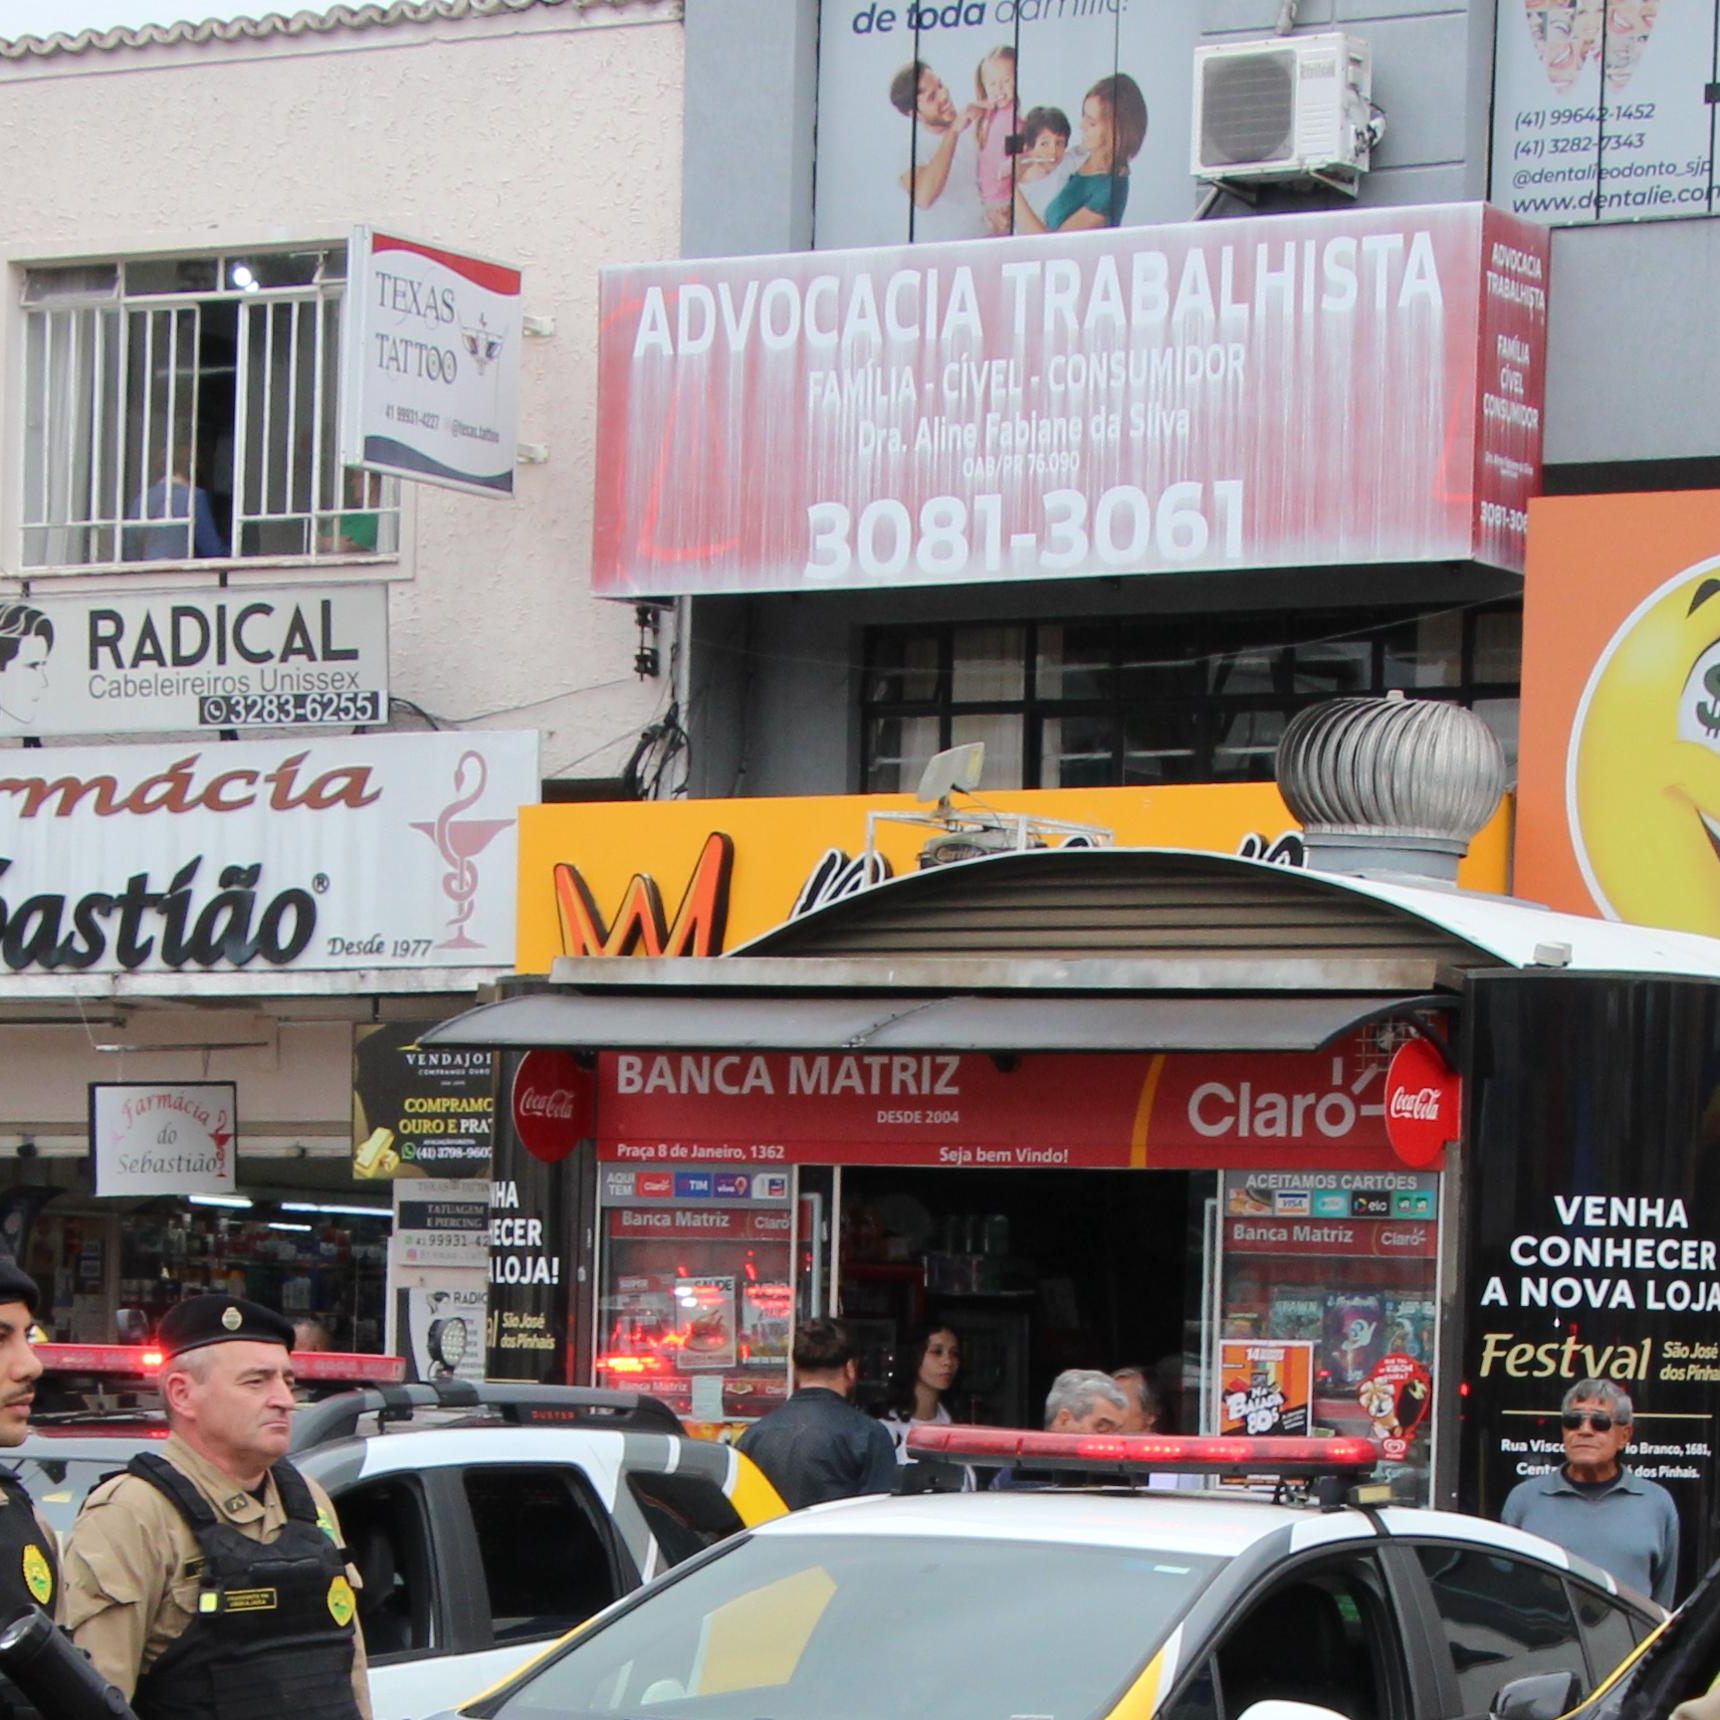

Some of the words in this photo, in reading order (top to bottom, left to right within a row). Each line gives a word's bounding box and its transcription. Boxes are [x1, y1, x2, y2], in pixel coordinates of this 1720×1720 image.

[852, 8, 897, 34] de
[907, 0, 985, 31] toda
[1514, 110, 1546, 131] (41)
[1550, 103, 1656, 126] 99642-1452
[1514, 141, 1545, 159] (41)
[1513, 156, 1713, 189] @dentalieodonto_sjp
[1491, 243, 1542, 277] ADVOCACIA
[375, 271, 456, 325] TEXAS
[633, 266, 983, 357] ADVOCACIA
[1001, 231, 1444, 335] TRABALHISTA
[1486, 271, 1546, 309] TRABALHISTA
[375, 332, 458, 384] TATTOO
[1497, 335, 1530, 364] FAMÍLIA
[807, 357, 918, 408] FAMÍLIA
[942, 353, 1022, 400] CÍVEL
[1048, 343, 1246, 392] CONSUMIDOR
[1483, 393, 1539, 428] CONSUMIDOR
[859, 421, 907, 455] Dra.
[915, 416, 976, 452] Aline
[984, 409, 1081, 446] Fabiane
[1091, 406, 1120, 439] da
[1129, 402, 1190, 437] Silva
[804, 479, 1245, 582] 3081-3061
[88, 599, 360, 670] RADICAL
[88, 669, 250, 699] Cabeleireiros
[260, 667, 360, 692] Unissex
[230, 693, 373, 723] 3283-6255
[327, 936, 385, 959] Desde
[391, 938, 432, 959] 1977
[616, 1055, 775, 1095] BANCA
[788, 1055, 961, 1095] MATRIZ
[877, 1109, 923, 1124] DESDE
[926, 1110, 959, 1124] 2004
[1187, 1081, 1357, 1138] Claro
[156, 1122, 177, 1145] do
[398, 1118, 445, 1133] OURO
[447, 1119, 458, 1133] E
[116, 1150, 218, 1174] Sebastião
[617, 1143, 655, 1160] Praça
[657, 1144, 667, 1158] 8
[669, 1143, 688, 1158] de
[690, 1144, 747, 1160] Janeiro,
[750, 1145, 784, 1159] 1362
[939, 1147, 972, 1164] Seja
[975, 1146, 1012, 1162] bem
[1015, 1147, 1069, 1163] Vindo!
[606, 1172, 635, 1185] AQUI
[608, 1184, 632, 1196] TEM
[689, 1179, 709, 1191] TIM
[1245, 1174, 1337, 1189] ACEITAMOS
[1340, 1173, 1418, 1190] CARTÕES
[427, 1204, 484, 1214] TATUAGEM
[621, 1212, 672, 1227] Banca
[675, 1211, 730, 1227] Matriz
[1553, 1196, 1689, 1229] VENHA
[1233, 1223, 1288, 1241] Banca
[1292, 1224, 1354, 1243] Matriz
[1380, 1231, 1421, 1246] Claro
[1510, 1235, 1717, 1271] CONHECER
[1480, 1276, 1509, 1306] A
[1520, 1277, 1635, 1308] NOVA
[1479, 1332, 1652, 1381] Festval
[1662, 1340, 1689, 1360] São
[1691, 1341, 1720, 1361] José
[1659, 1364, 1684, 1381] dos
[1501, 1438, 1528, 1452] Rua
[1639, 1442, 1684, 1457] Branco,
[1685, 1443, 1712, 1457] 1681,
[1634, 1464, 1657, 1478] dos
[1658, 1465, 1700, 1479] Pinhais.
